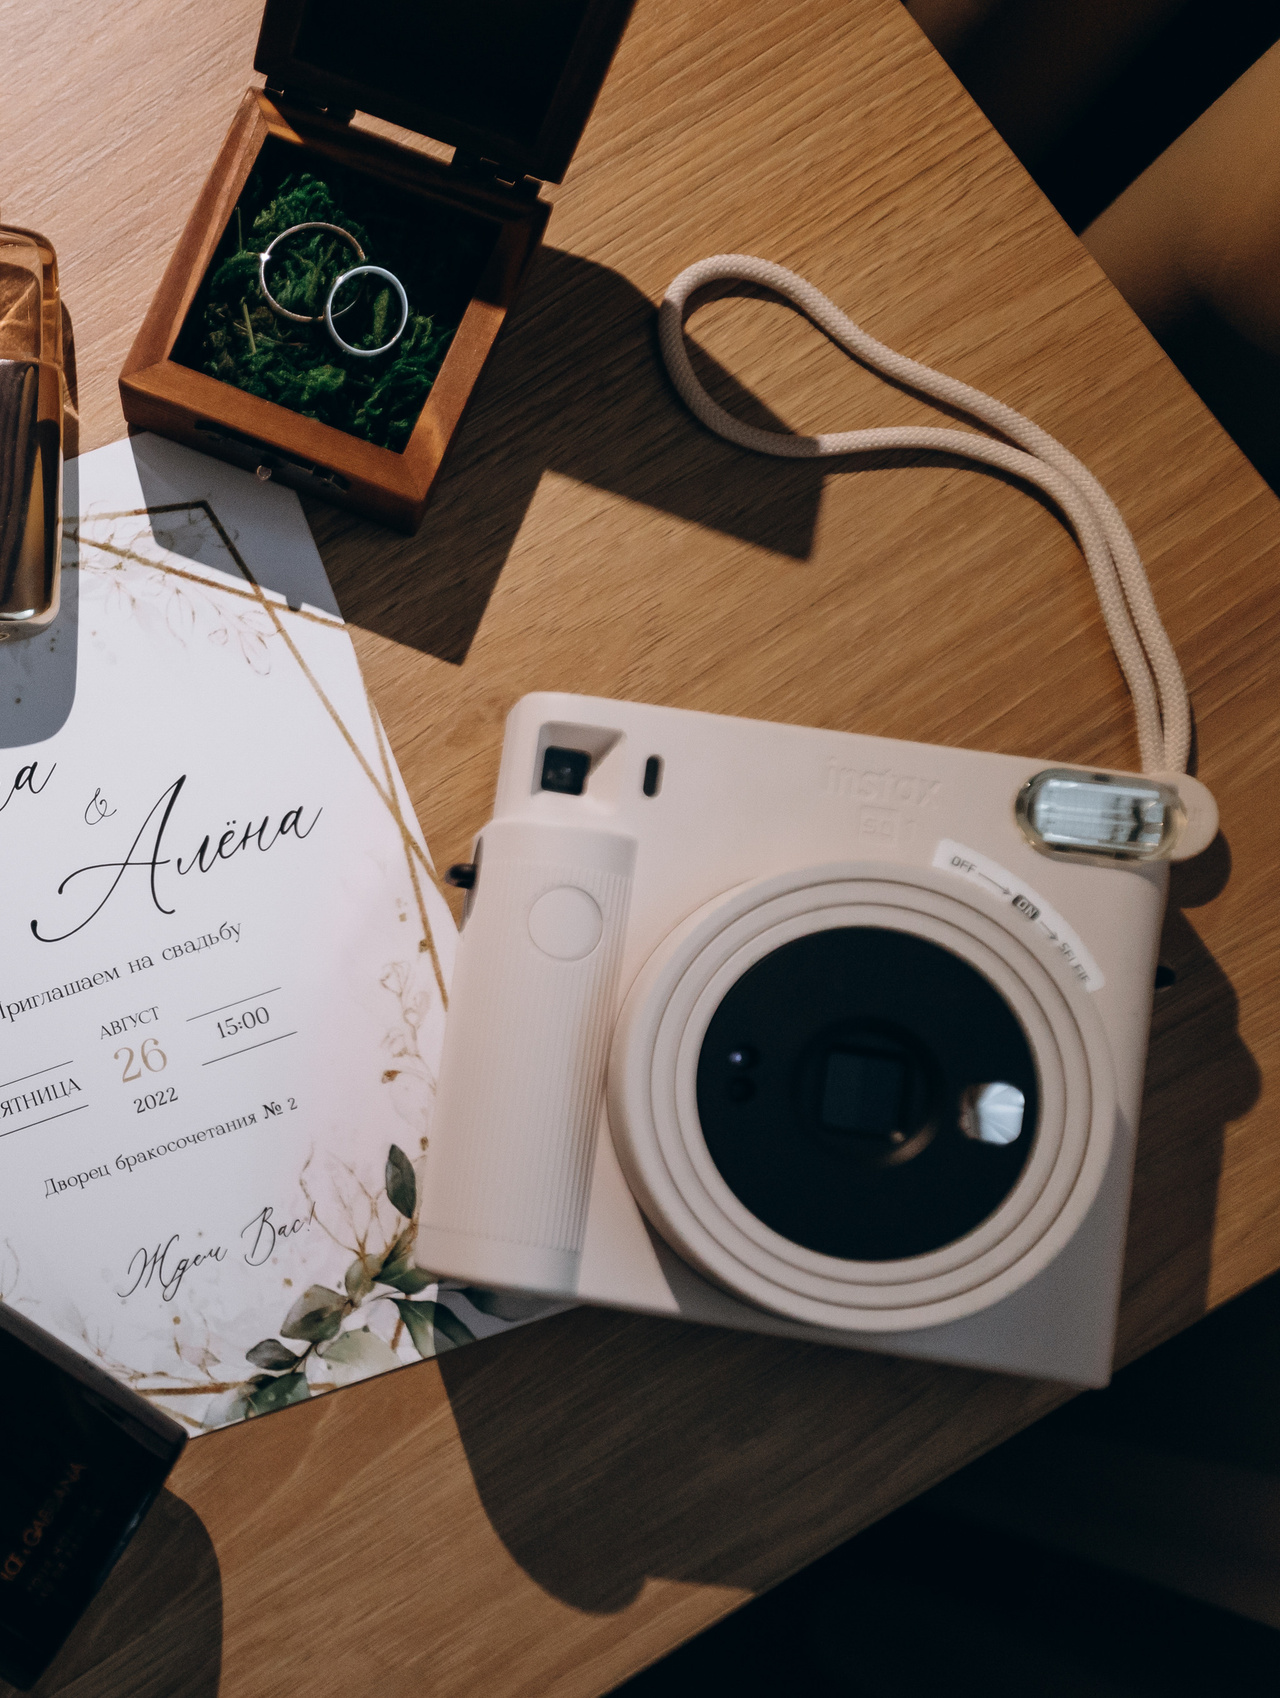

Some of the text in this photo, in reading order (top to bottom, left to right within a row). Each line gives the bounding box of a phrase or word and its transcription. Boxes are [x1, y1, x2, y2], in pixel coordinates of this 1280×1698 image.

[84, 787, 118, 826] &
[30, 774, 324, 943] Алёна
[950, 855, 977, 873] OFF
[1015, 897, 1040, 919] ON
[127, 954, 155, 974] на
[161, 920, 242, 962] свадьбу
[99, 1006, 160, 1040] АВГУСТ
[215, 1005, 271, 1040] 15:00
[113, 1037, 168, 1084] 26
[132, 1086, 179, 1114] 2022
[43, 1096, 298, 1200] Дворец бракосочетания № 2
[116, 1201, 318, 1303] Ждем Вас!
